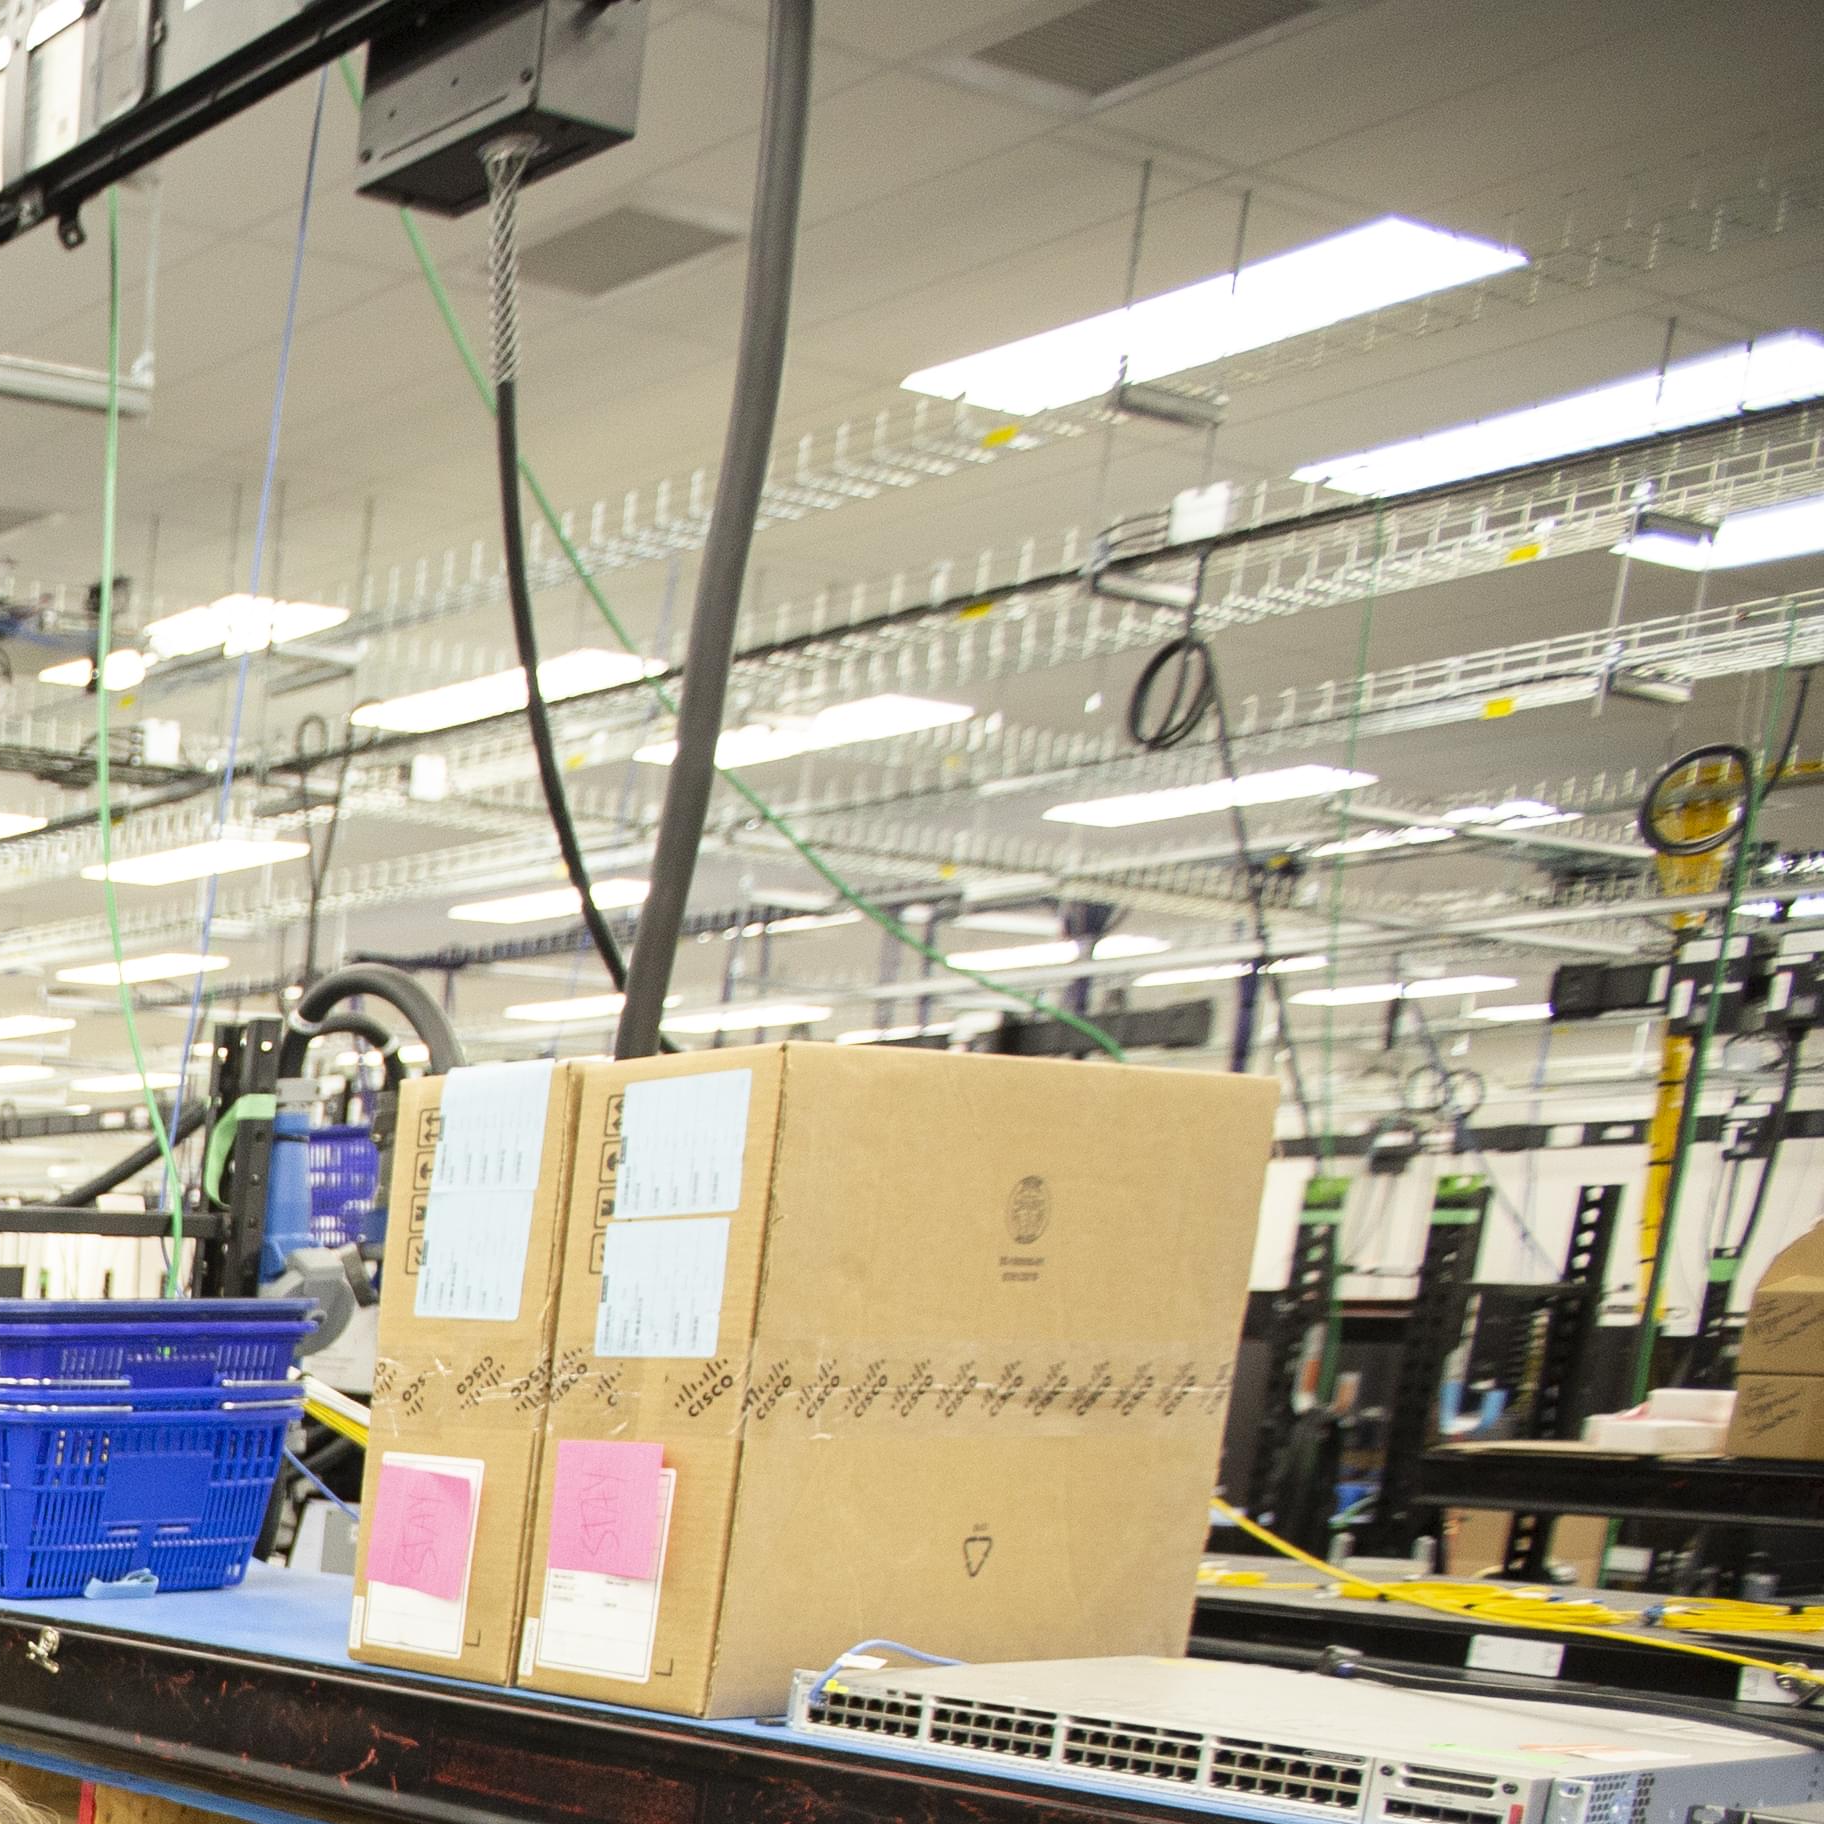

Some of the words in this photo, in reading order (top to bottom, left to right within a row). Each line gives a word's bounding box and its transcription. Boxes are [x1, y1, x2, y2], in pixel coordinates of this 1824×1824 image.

[688, 1374, 733, 1417] CISCO
[756, 1375, 792, 1420] CISCO
[806, 1375, 840, 1419] CISCO
[854, 1374, 887, 1418] CISCO
[901, 1374, 933, 1417] CISCO
[401, 1494, 440, 1573] STAY
[579, 1472, 632, 1556] STAY
